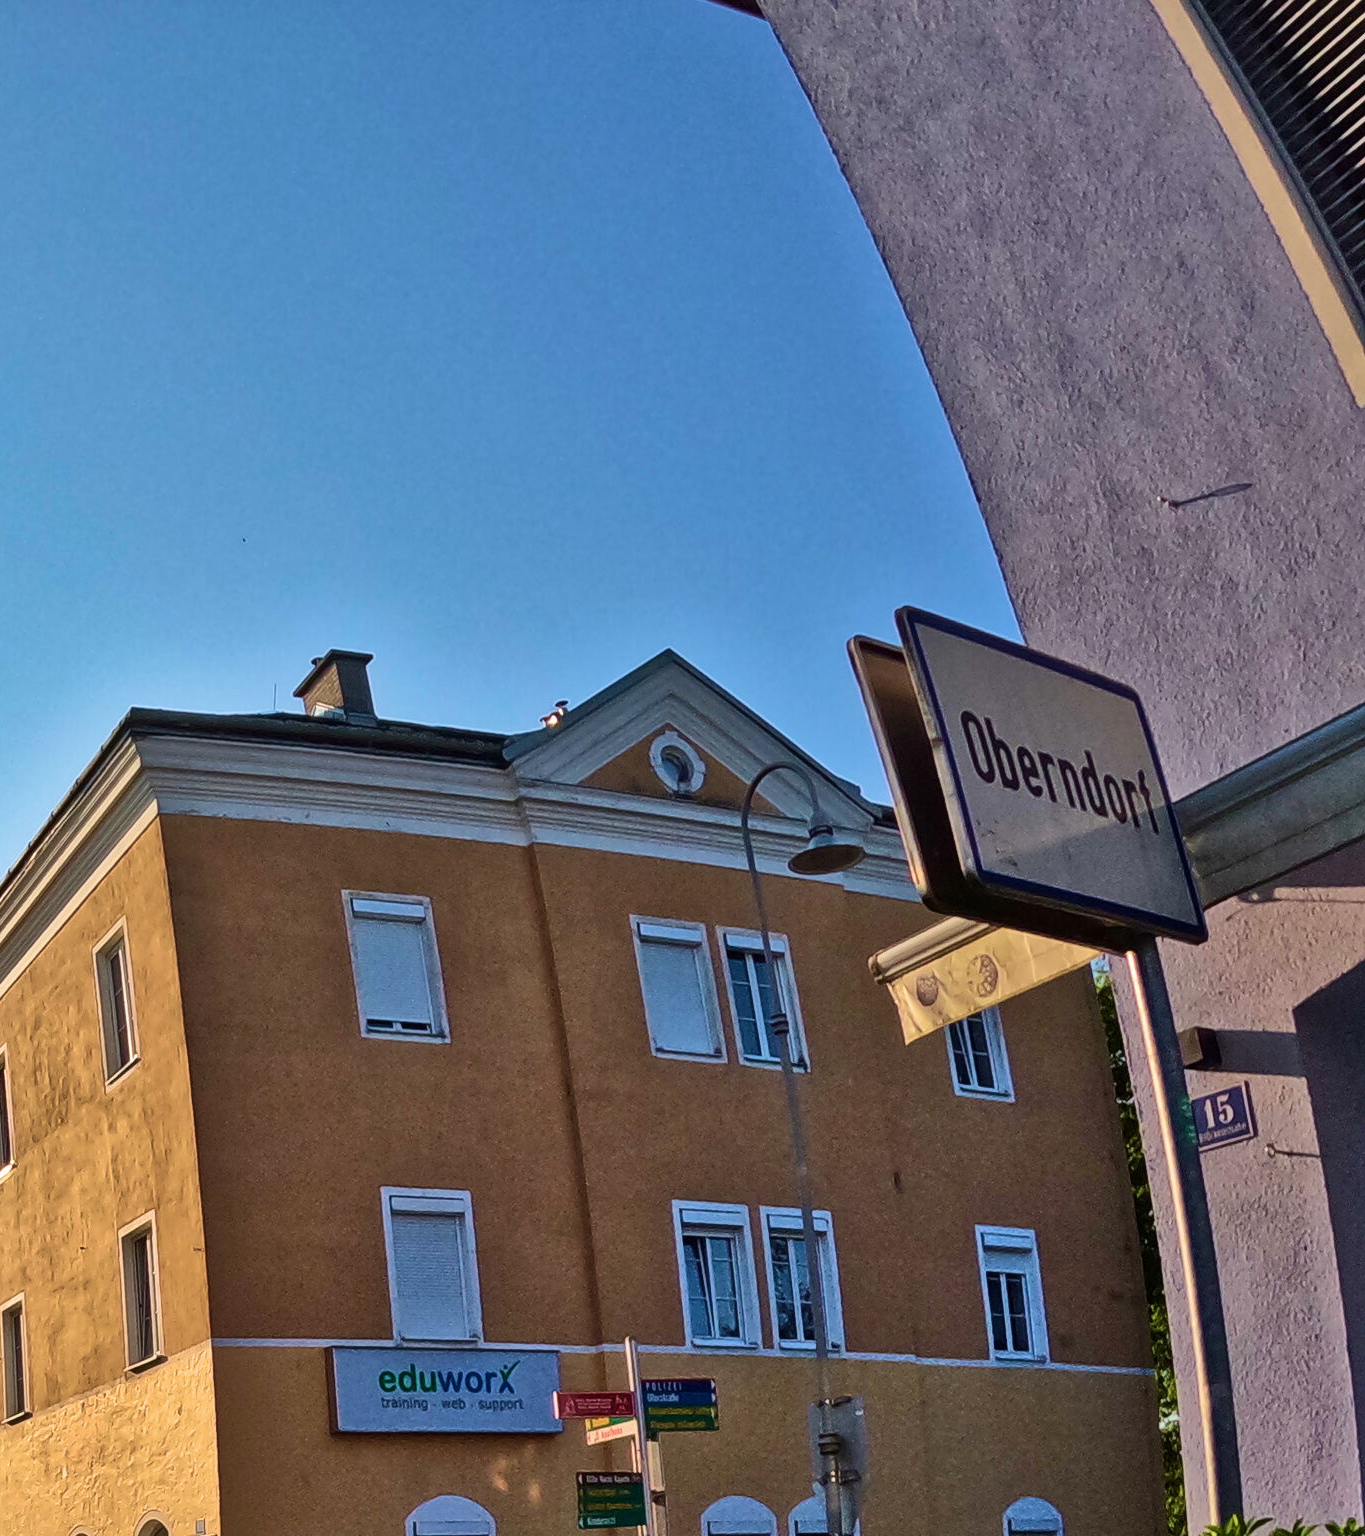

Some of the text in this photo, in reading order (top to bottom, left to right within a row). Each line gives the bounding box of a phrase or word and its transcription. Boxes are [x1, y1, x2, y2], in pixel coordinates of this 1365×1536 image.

[959, 709, 1159, 836] Oberndorf
[1203, 1092, 1235, 1130] 15
[378, 1360, 521, 1394] eduworx
[645, 1382, 683, 1392] POLIZEI
[380, 1397, 525, 1412] training web support
